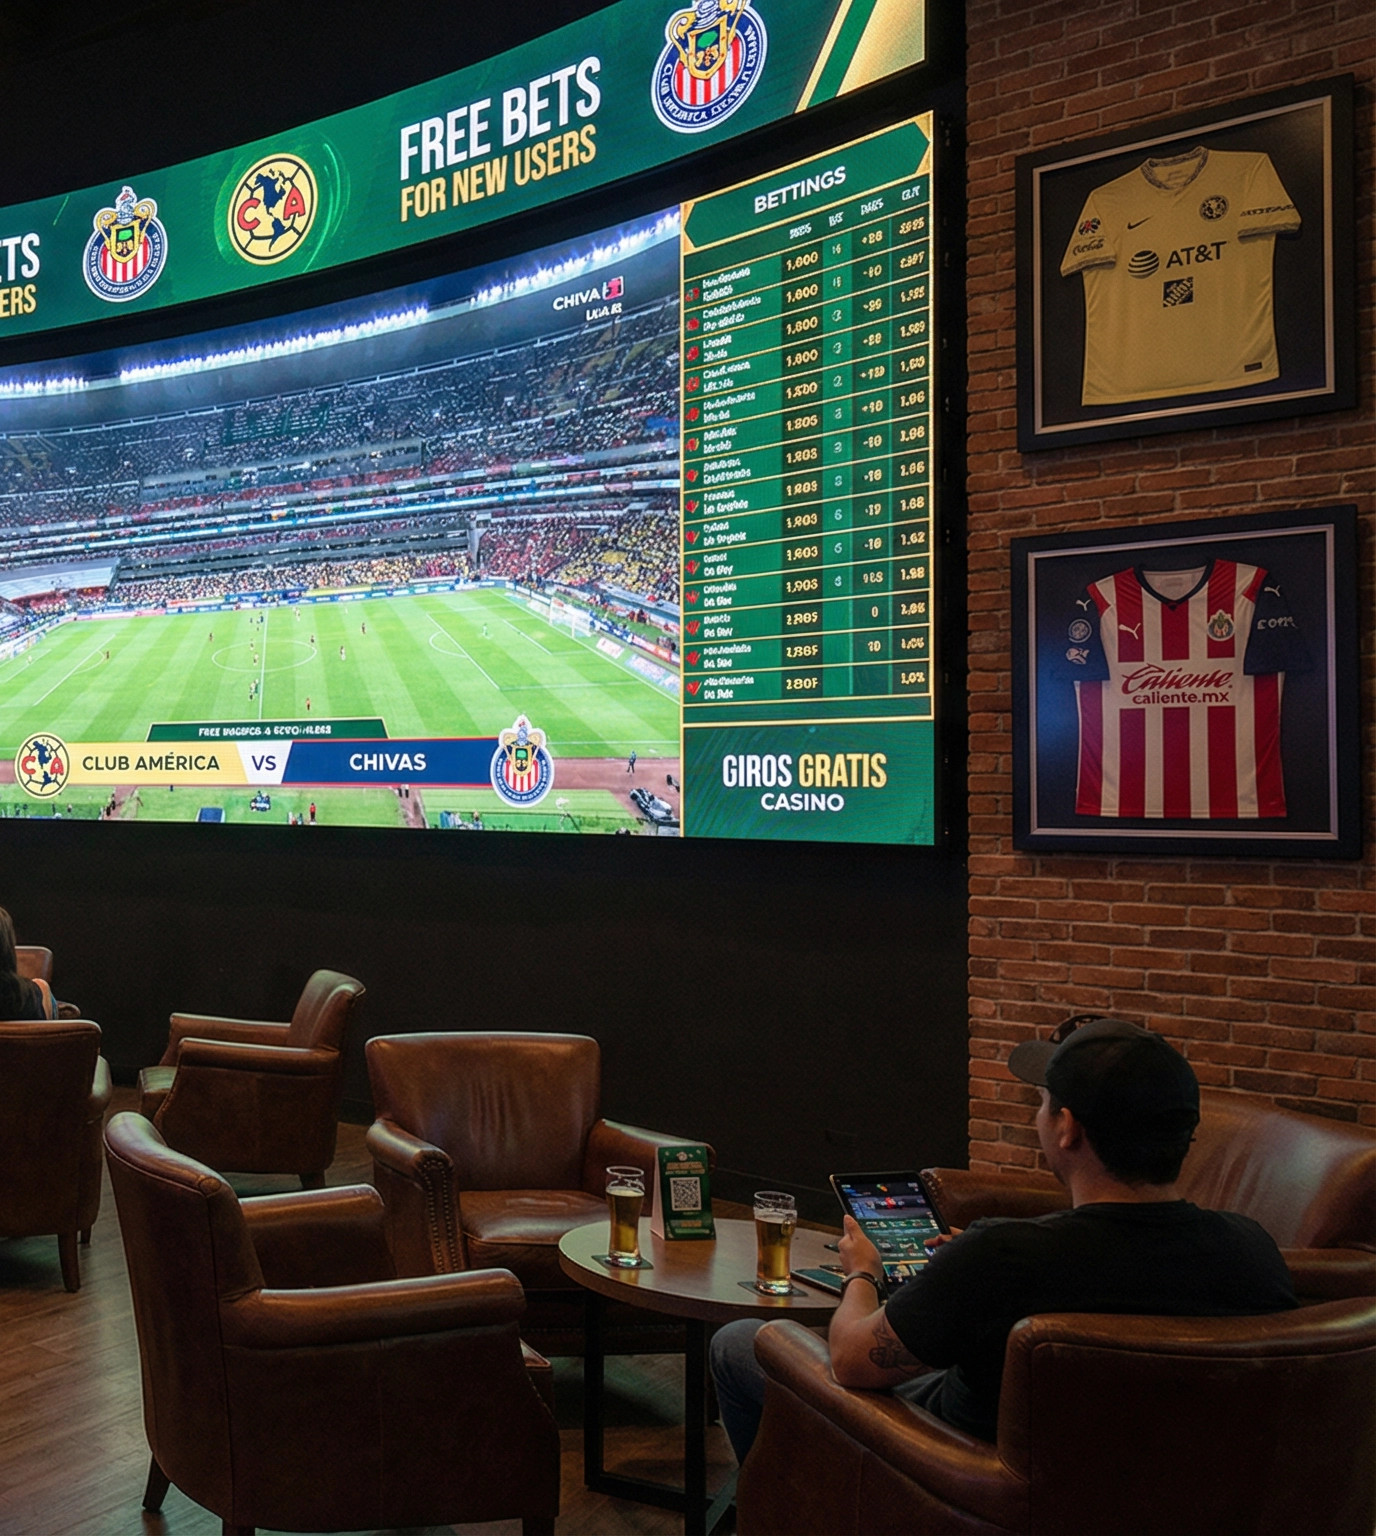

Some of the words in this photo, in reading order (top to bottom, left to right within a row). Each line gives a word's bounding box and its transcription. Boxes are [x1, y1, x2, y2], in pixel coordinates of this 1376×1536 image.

[401, 98, 490, 180] FREE
[503, 57, 600, 146] BETS
[402, 178, 445, 221] FOR
[453, 155, 507, 206] NEW
[515, 124, 596, 185] USERS
[755, 166, 846, 213] BETTINGS
[1166, 241, 1227, 268] AT&T
[1132, 691, 1230, 705] caliente.mx
[83, 756, 129, 770] CLUB
[135, 752, 219, 770] AMÉRICA
[252, 756, 276, 770] VS
[350, 754, 426, 770] CHIVAS
[723, 755, 792, 787] GIROS
[799, 753, 886, 787] GRATIS
[761, 793, 844, 811] CASINO
